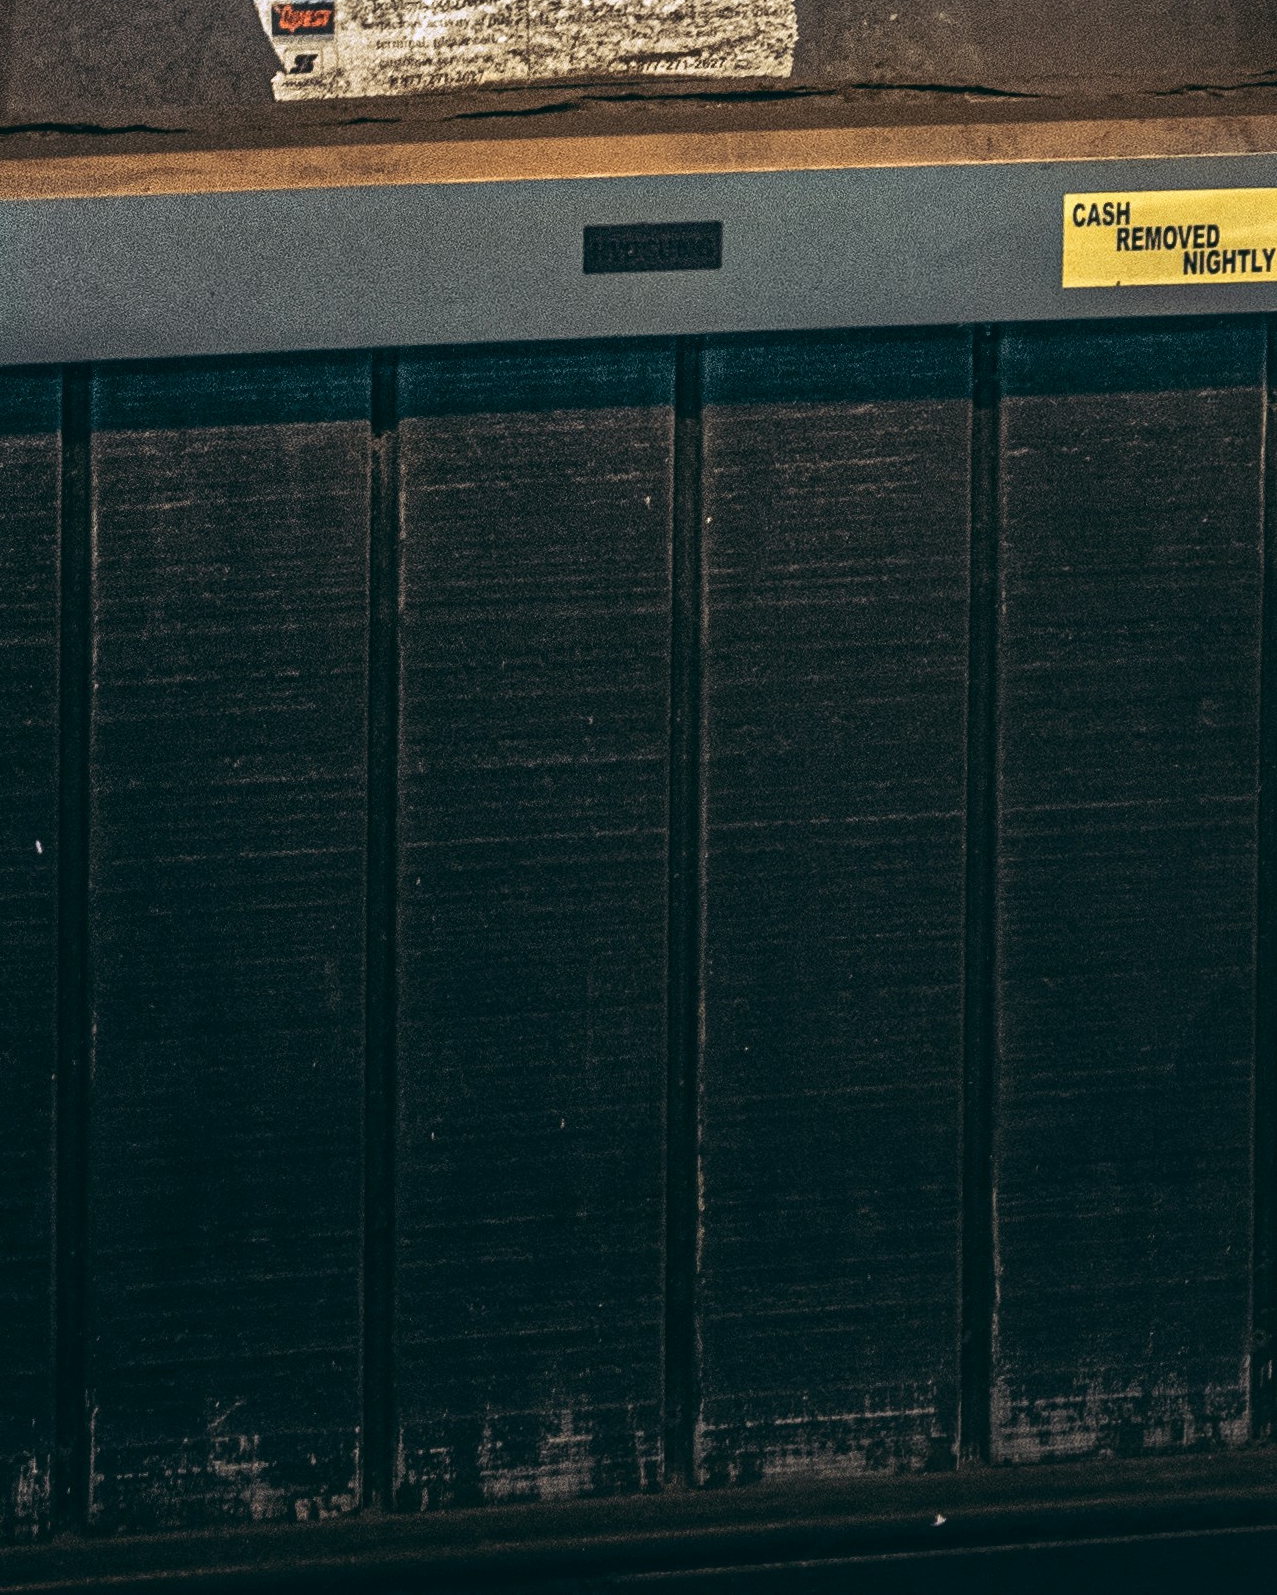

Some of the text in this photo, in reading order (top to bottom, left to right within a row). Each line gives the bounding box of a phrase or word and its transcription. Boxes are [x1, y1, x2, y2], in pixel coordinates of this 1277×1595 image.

[1073, 201, 1131, 227] CASH
[1116, 224, 1220, 252] REMOVED
[1183, 247, 1276, 275] NIGHTLY
